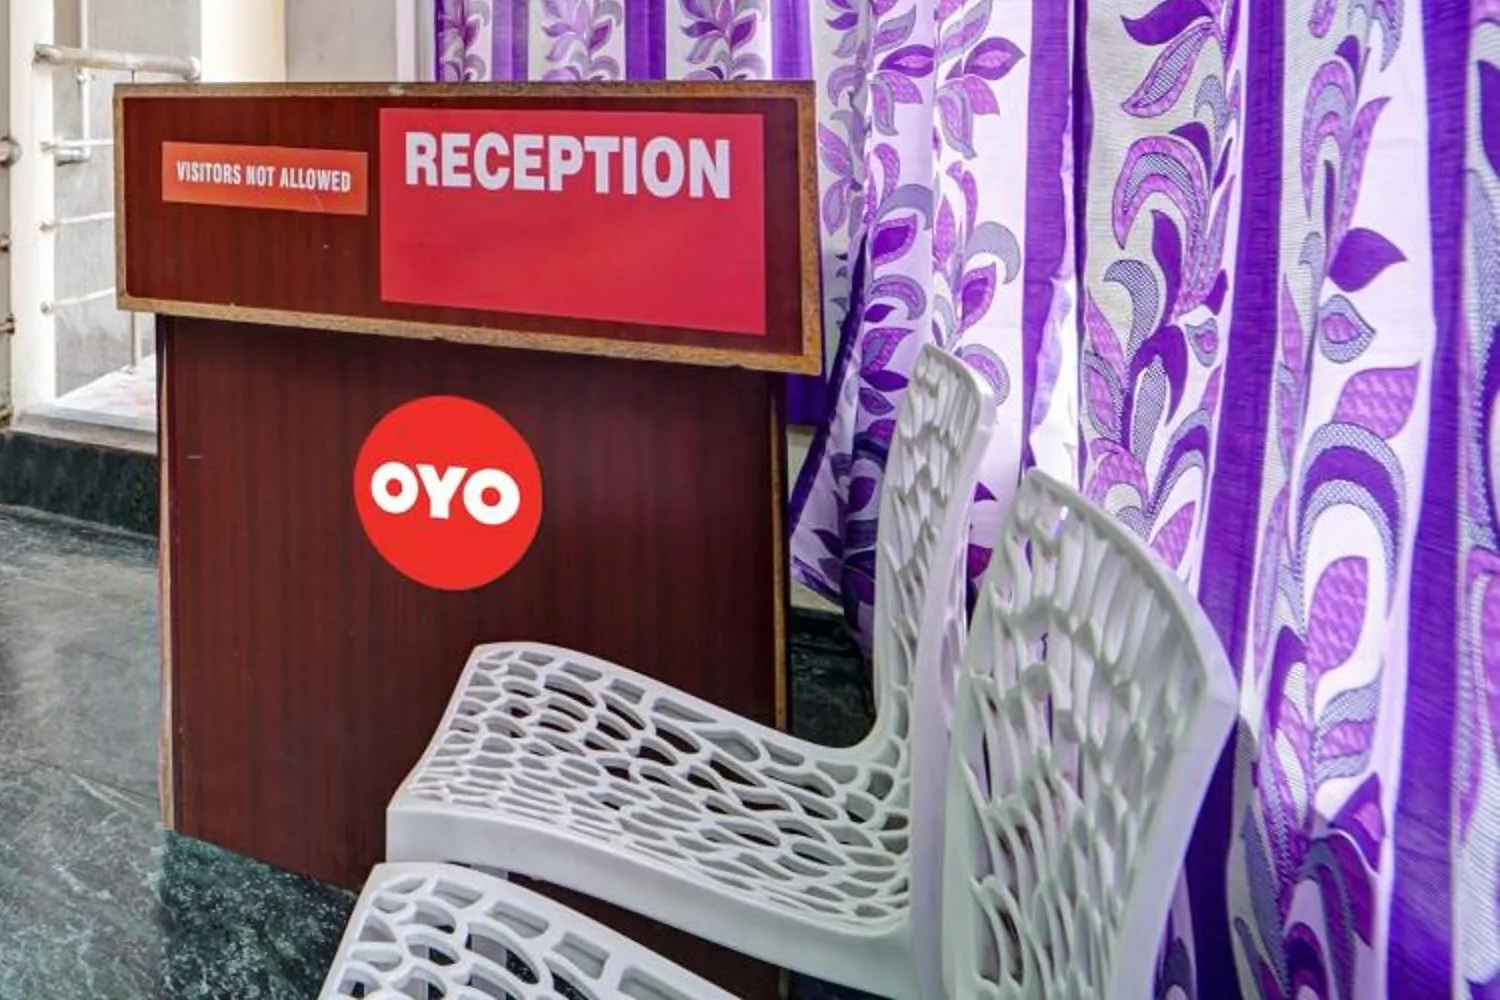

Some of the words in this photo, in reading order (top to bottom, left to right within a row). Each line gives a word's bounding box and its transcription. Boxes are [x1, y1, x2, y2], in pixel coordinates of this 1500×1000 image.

[175, 160, 241, 184] VISITORS
[246, 165, 275, 187] NOT
[280, 168, 351, 193] ALLOWED
[405, 131, 731, 200] RECEPTION
[371, 461, 521, 526] OYO
